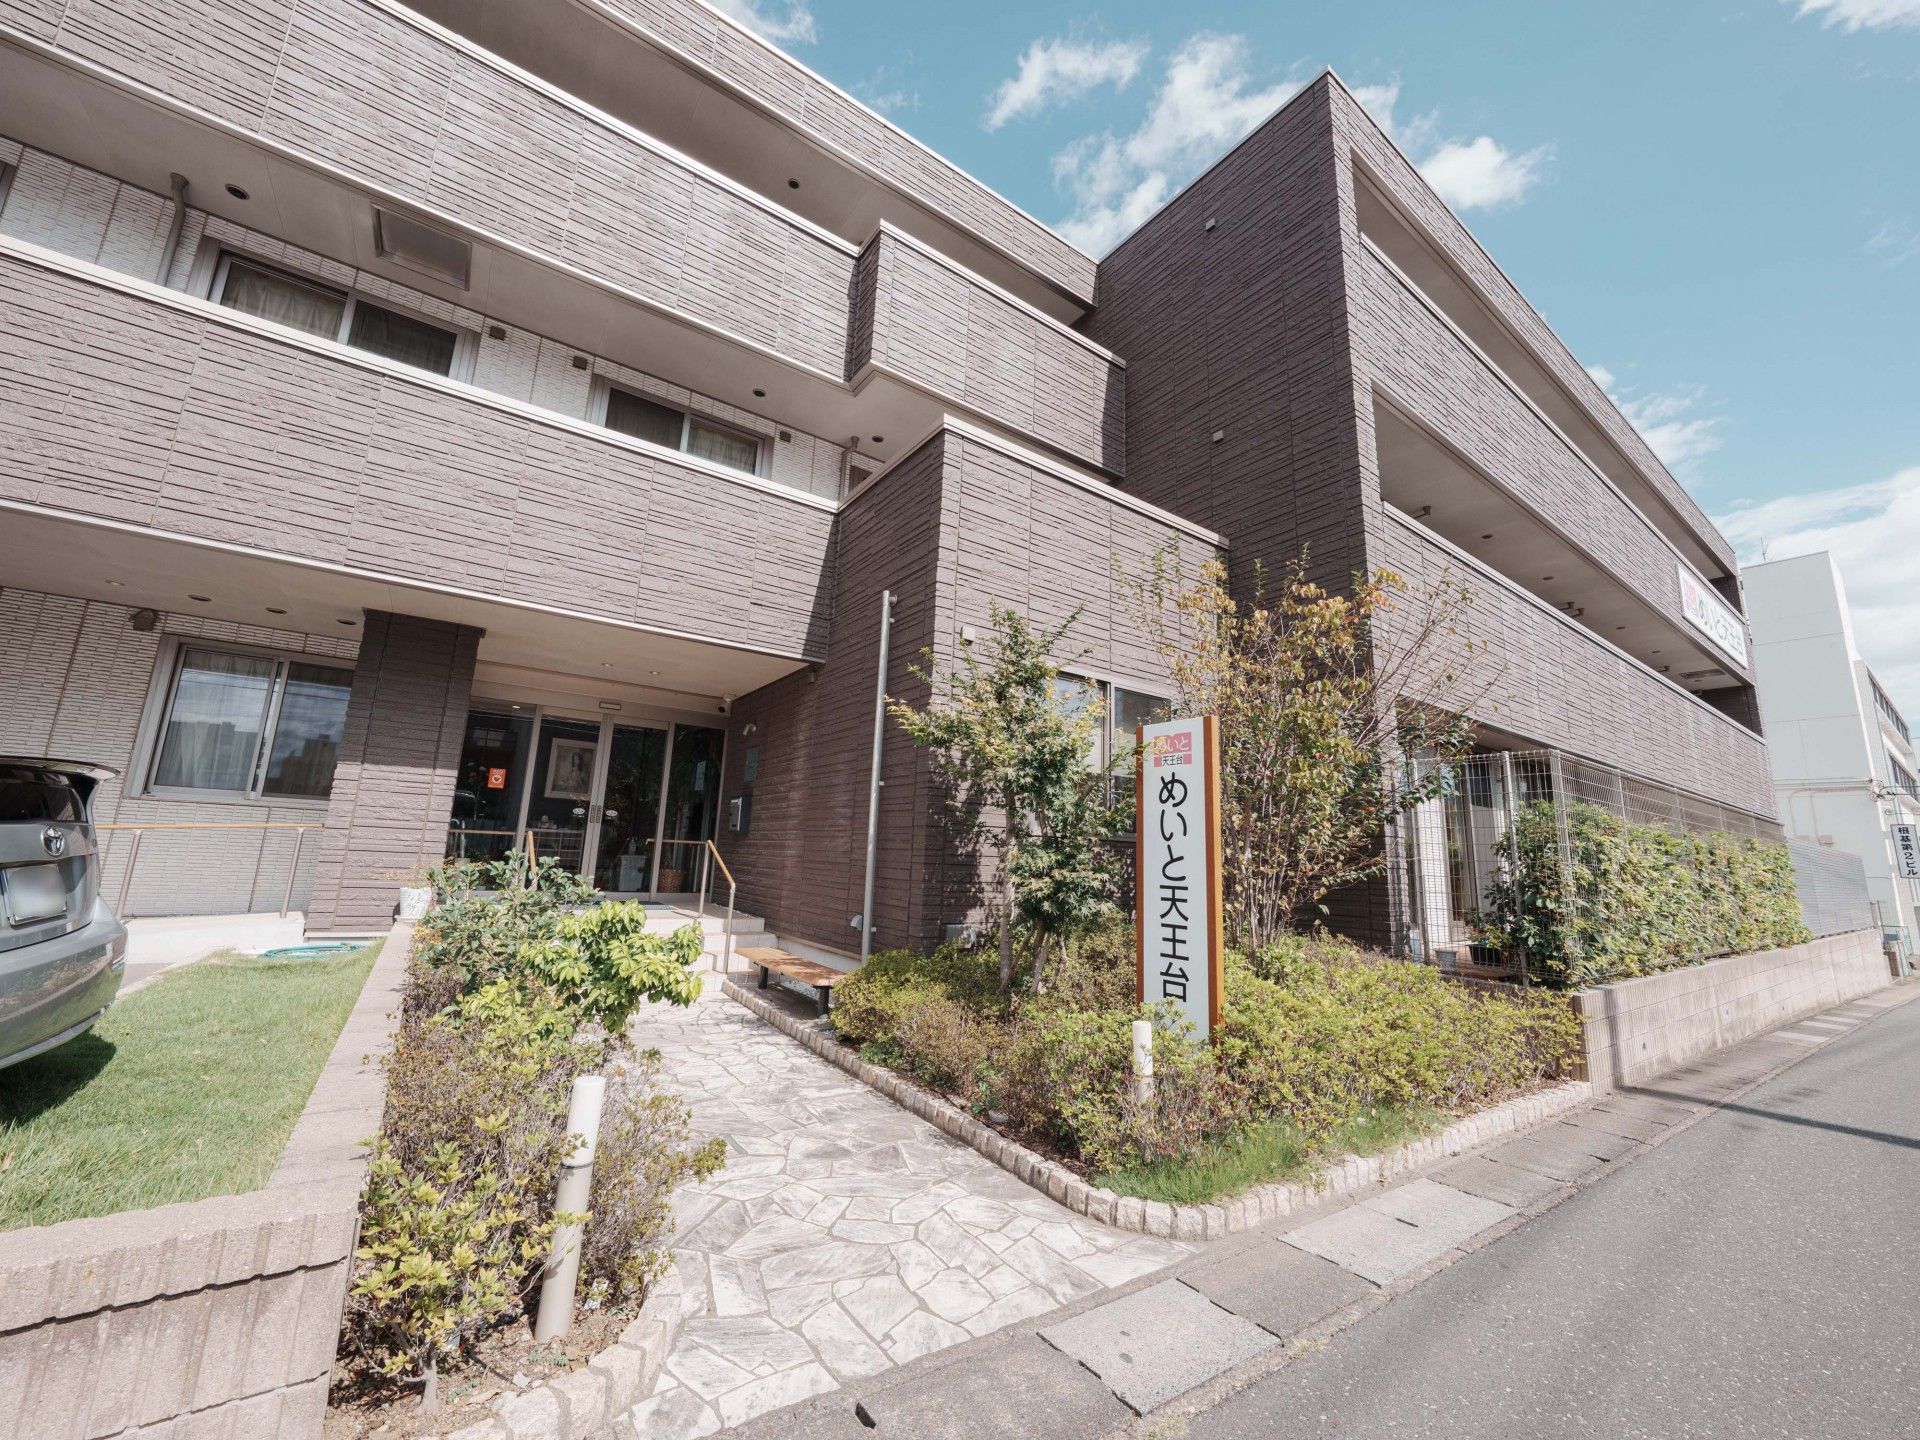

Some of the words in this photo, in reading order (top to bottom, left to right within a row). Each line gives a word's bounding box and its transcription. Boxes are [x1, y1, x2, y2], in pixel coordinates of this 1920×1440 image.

[1162, 754, 1183, 766] 天王台
[1158, 771, 1190, 1003] めいと天王台
